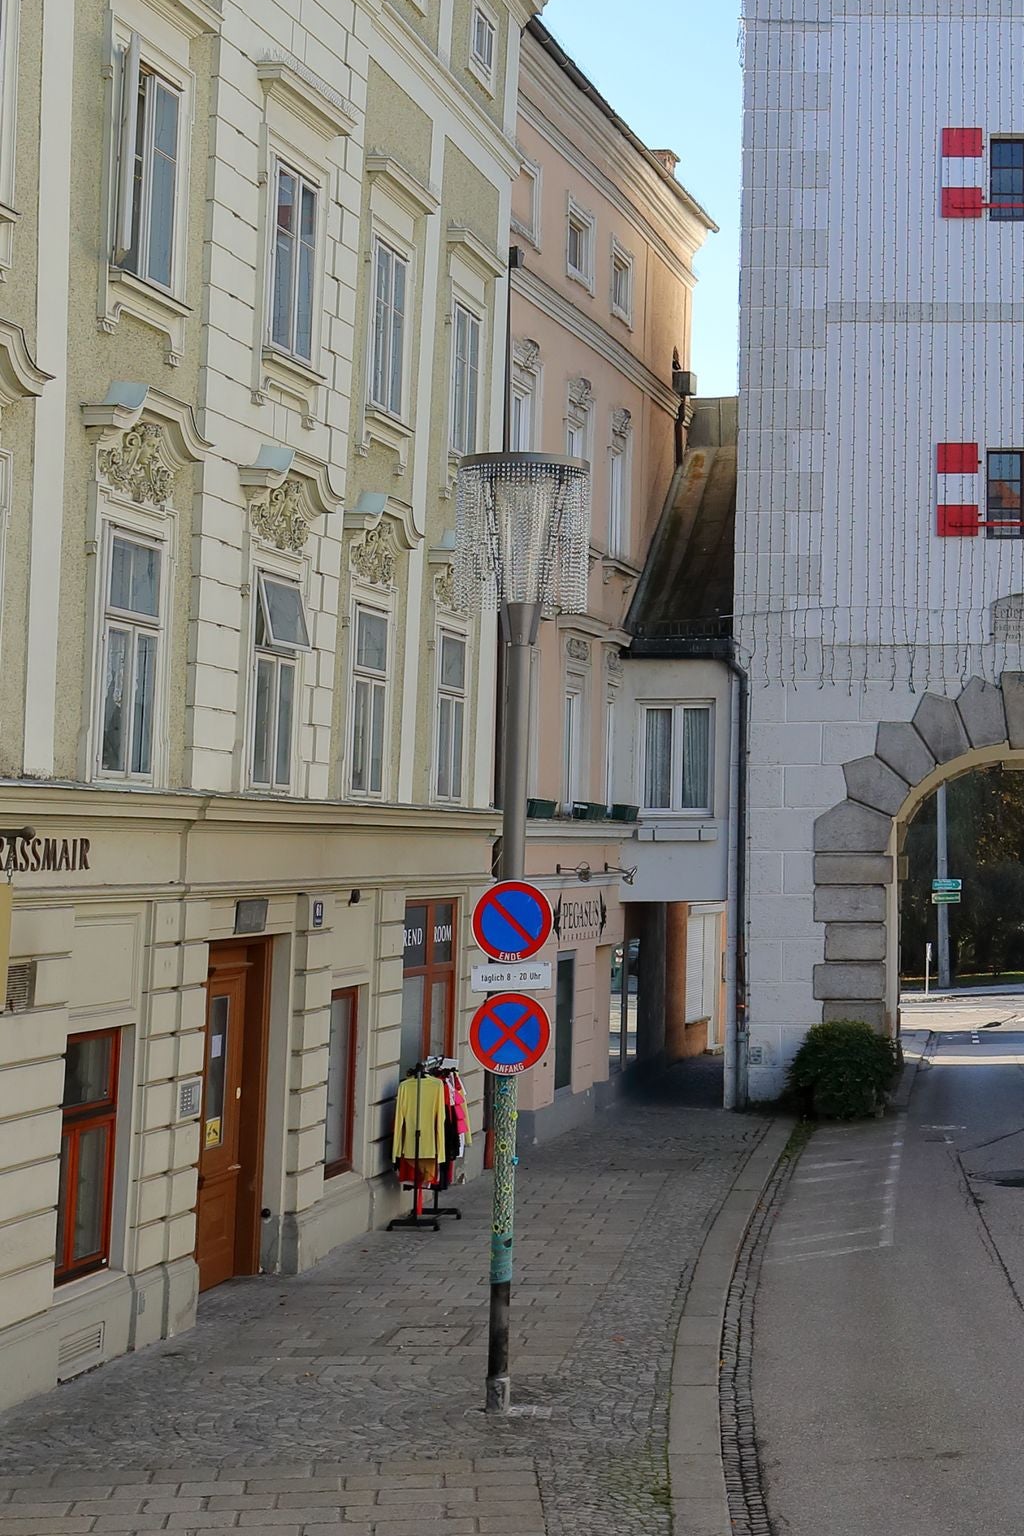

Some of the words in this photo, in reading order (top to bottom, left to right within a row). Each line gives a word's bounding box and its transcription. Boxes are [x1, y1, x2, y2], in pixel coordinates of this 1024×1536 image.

[563, 900, 600, 929] PEGASUS
[499, 952, 522, 961] ENDE
[506, 973, 511, 981] 8
[519, 972, 527, 981] 20
[529, 972, 541, 980] Uhr
[494, 1063, 525, 1073] ANFANG
